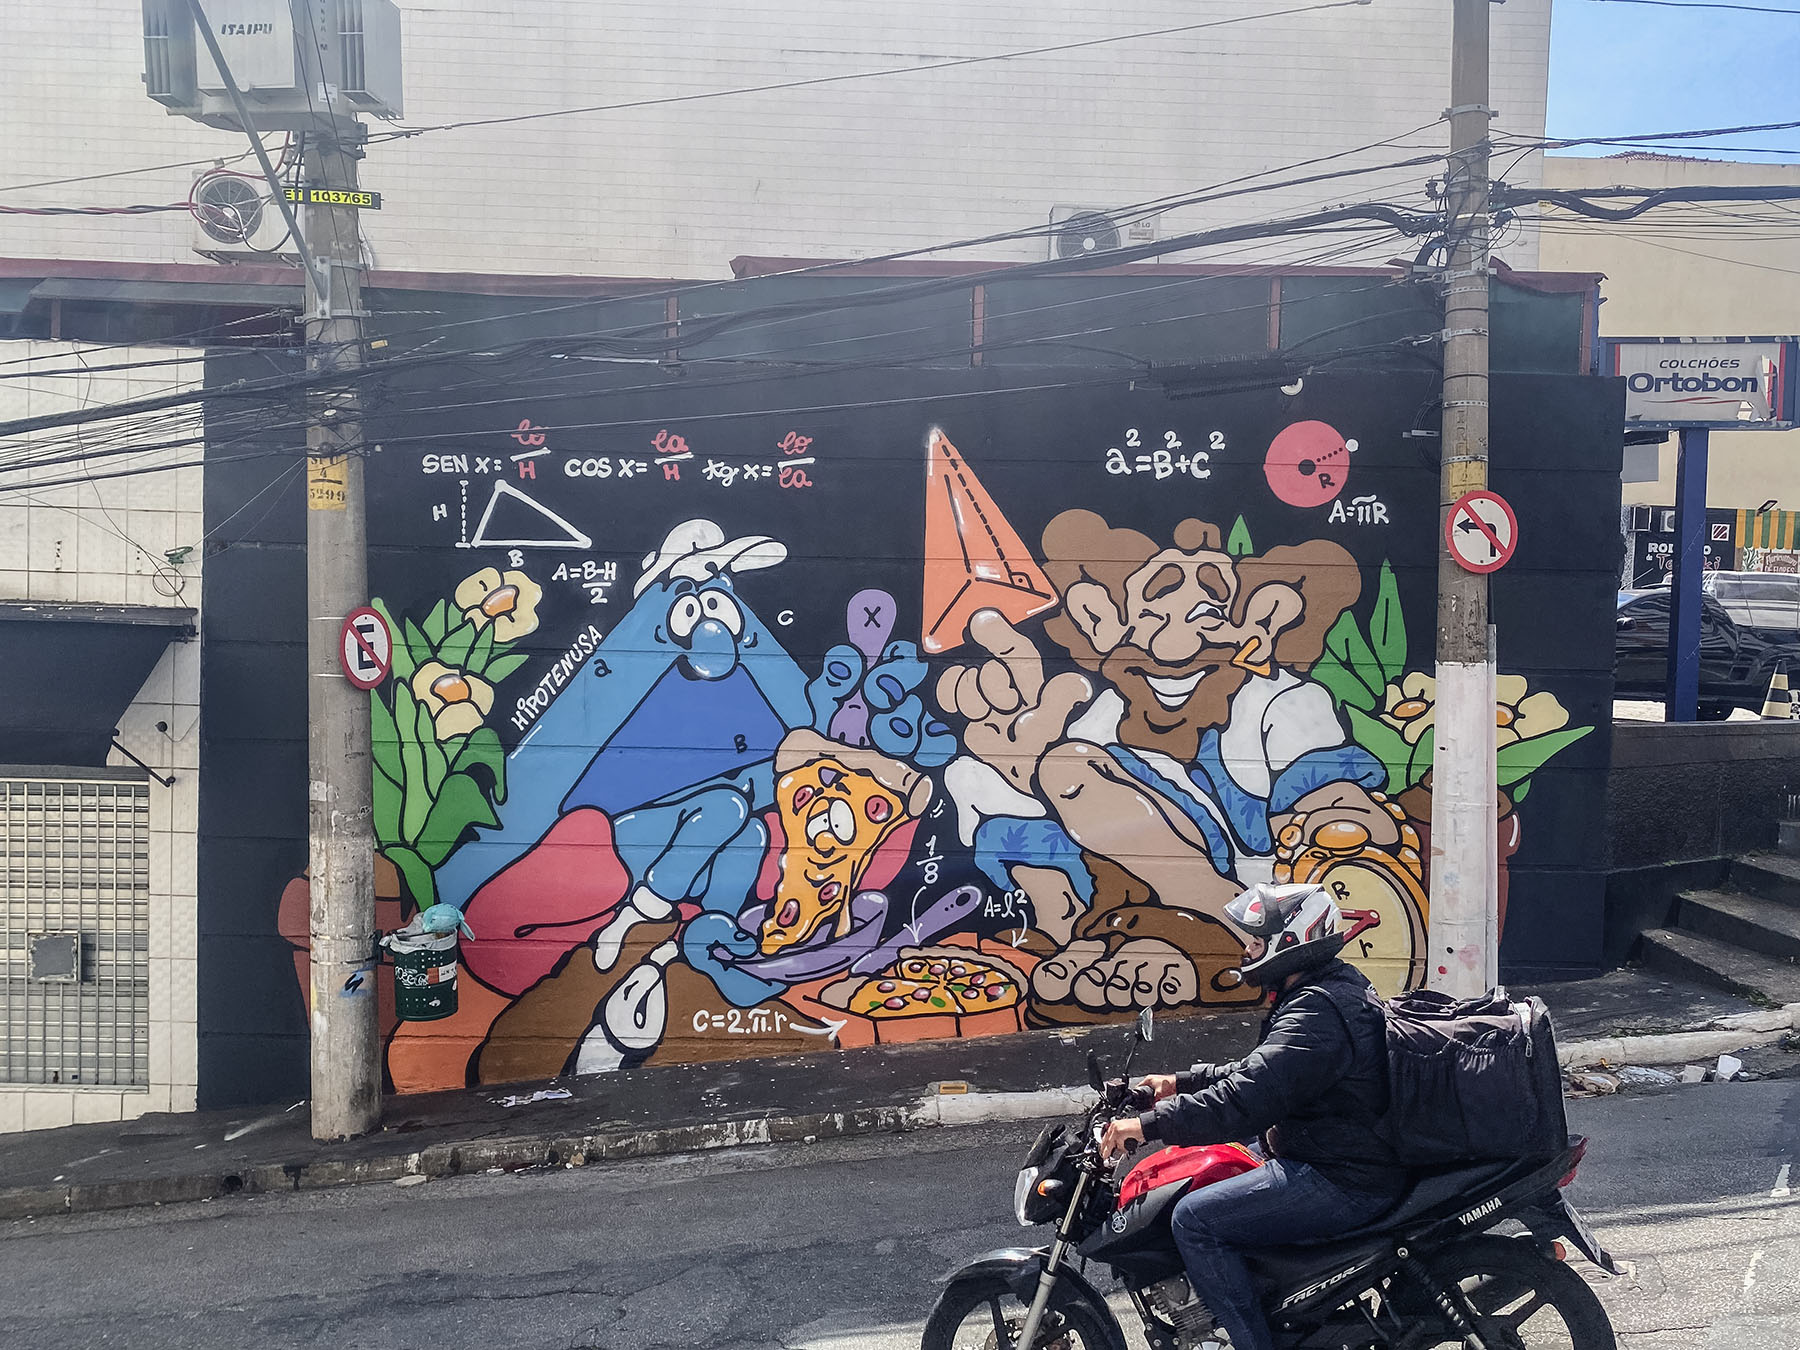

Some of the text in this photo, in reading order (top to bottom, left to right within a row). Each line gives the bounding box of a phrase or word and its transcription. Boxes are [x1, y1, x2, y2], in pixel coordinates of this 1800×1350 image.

[221, 23, 273, 36] ITAIPU
[312, 191, 371, 204] 103765
[1659, 356, 1740, 369] COLCHÕES
[1627, 372, 1758, 393] Ortobon
[422, 454, 469, 474] SEN
[518, 460, 537, 480] H
[564, 457, 613, 478] COS
[663, 464, 681, 481] H
[1319, 473, 1335, 489] R
[432, 503, 448, 522] H
[507, 549, 524, 568] B
[590, 587, 608, 604] 2
[734, 734, 748, 754] B
[923, 862, 940, 885] 8
[1331, 880, 1350, 901] R
[1458, 1196, 1503, 1226] YAMAHA
[1281, 1266, 1357, 1309] FACTOR
